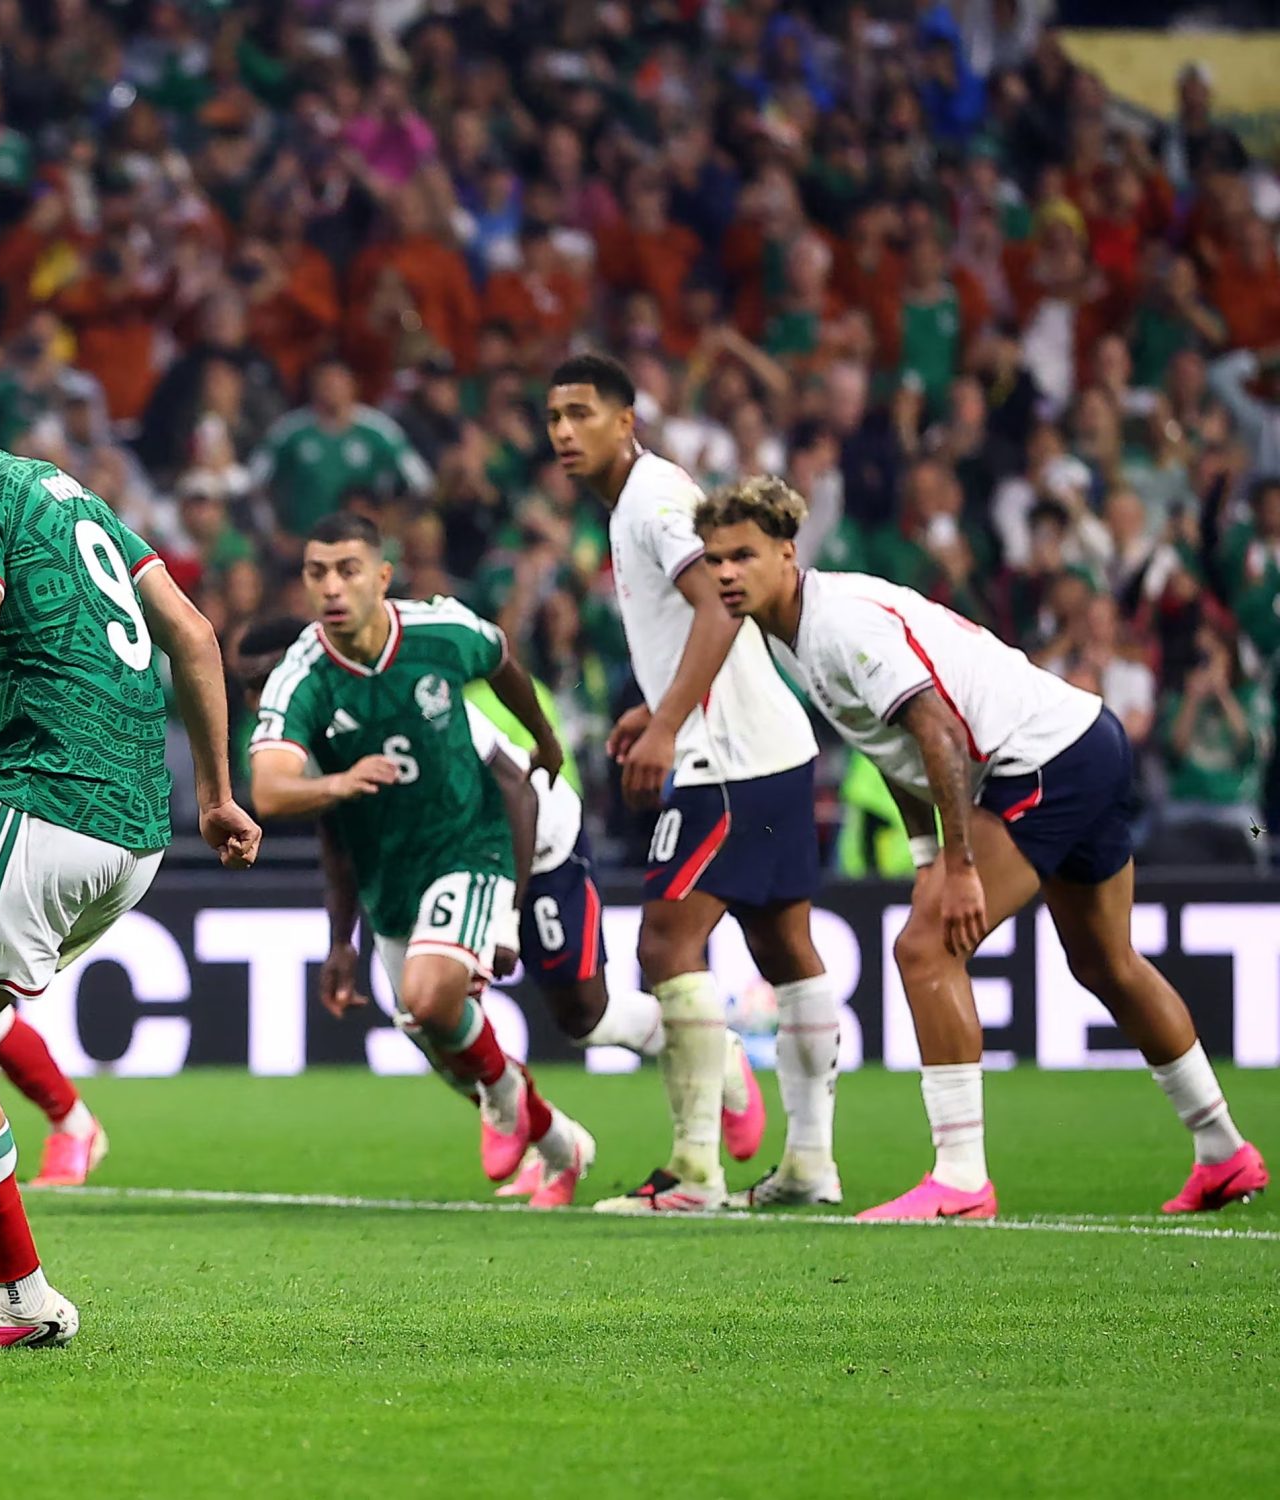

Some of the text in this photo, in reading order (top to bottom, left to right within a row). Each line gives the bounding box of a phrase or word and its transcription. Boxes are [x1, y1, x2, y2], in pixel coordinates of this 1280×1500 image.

[74, 519, 152, 672] 9
[430, 891, 456, 928] 6
[533, 895, 566, 951] 6
